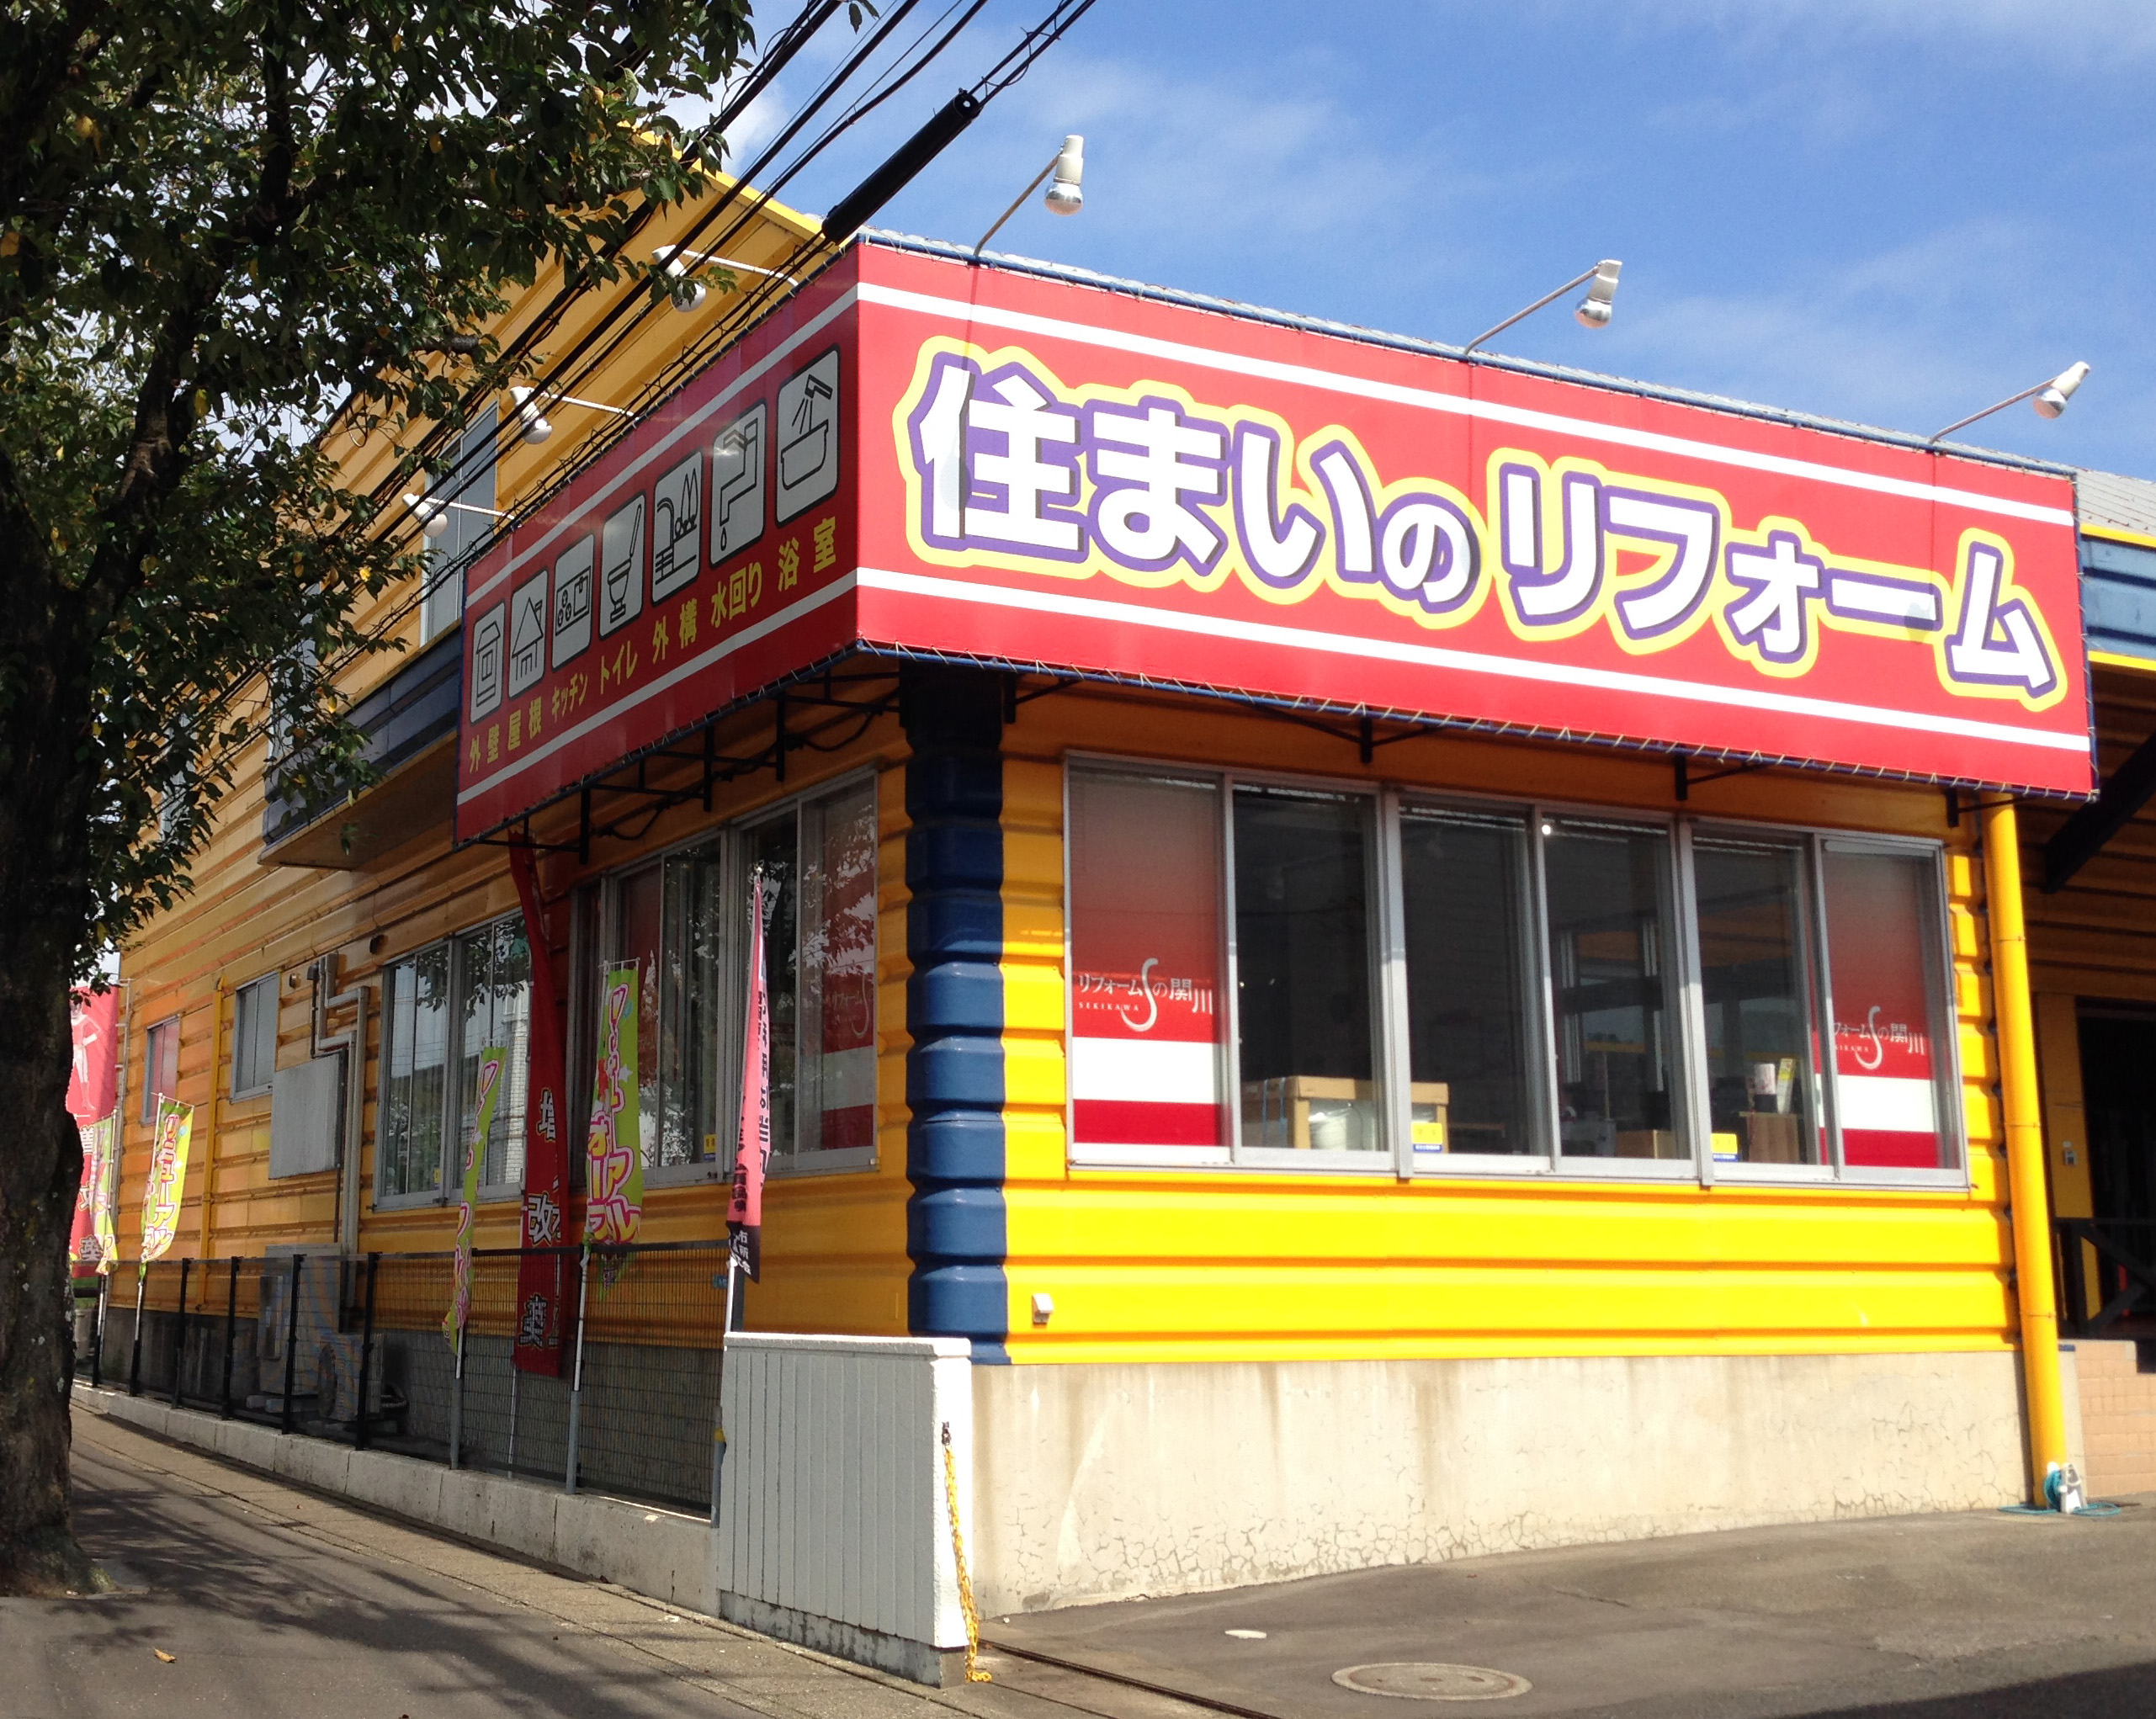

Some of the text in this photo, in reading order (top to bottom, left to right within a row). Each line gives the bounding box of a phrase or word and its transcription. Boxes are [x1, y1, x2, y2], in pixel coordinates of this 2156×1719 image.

[469, 517, 837, 772] 外壁 屋根 キッチン トイレ 外構 水回り 浴室
[909, 351, 2058, 698] 住まいのリフォーム
[1079, 1001, 1139, 1011] SEKIKAWA
